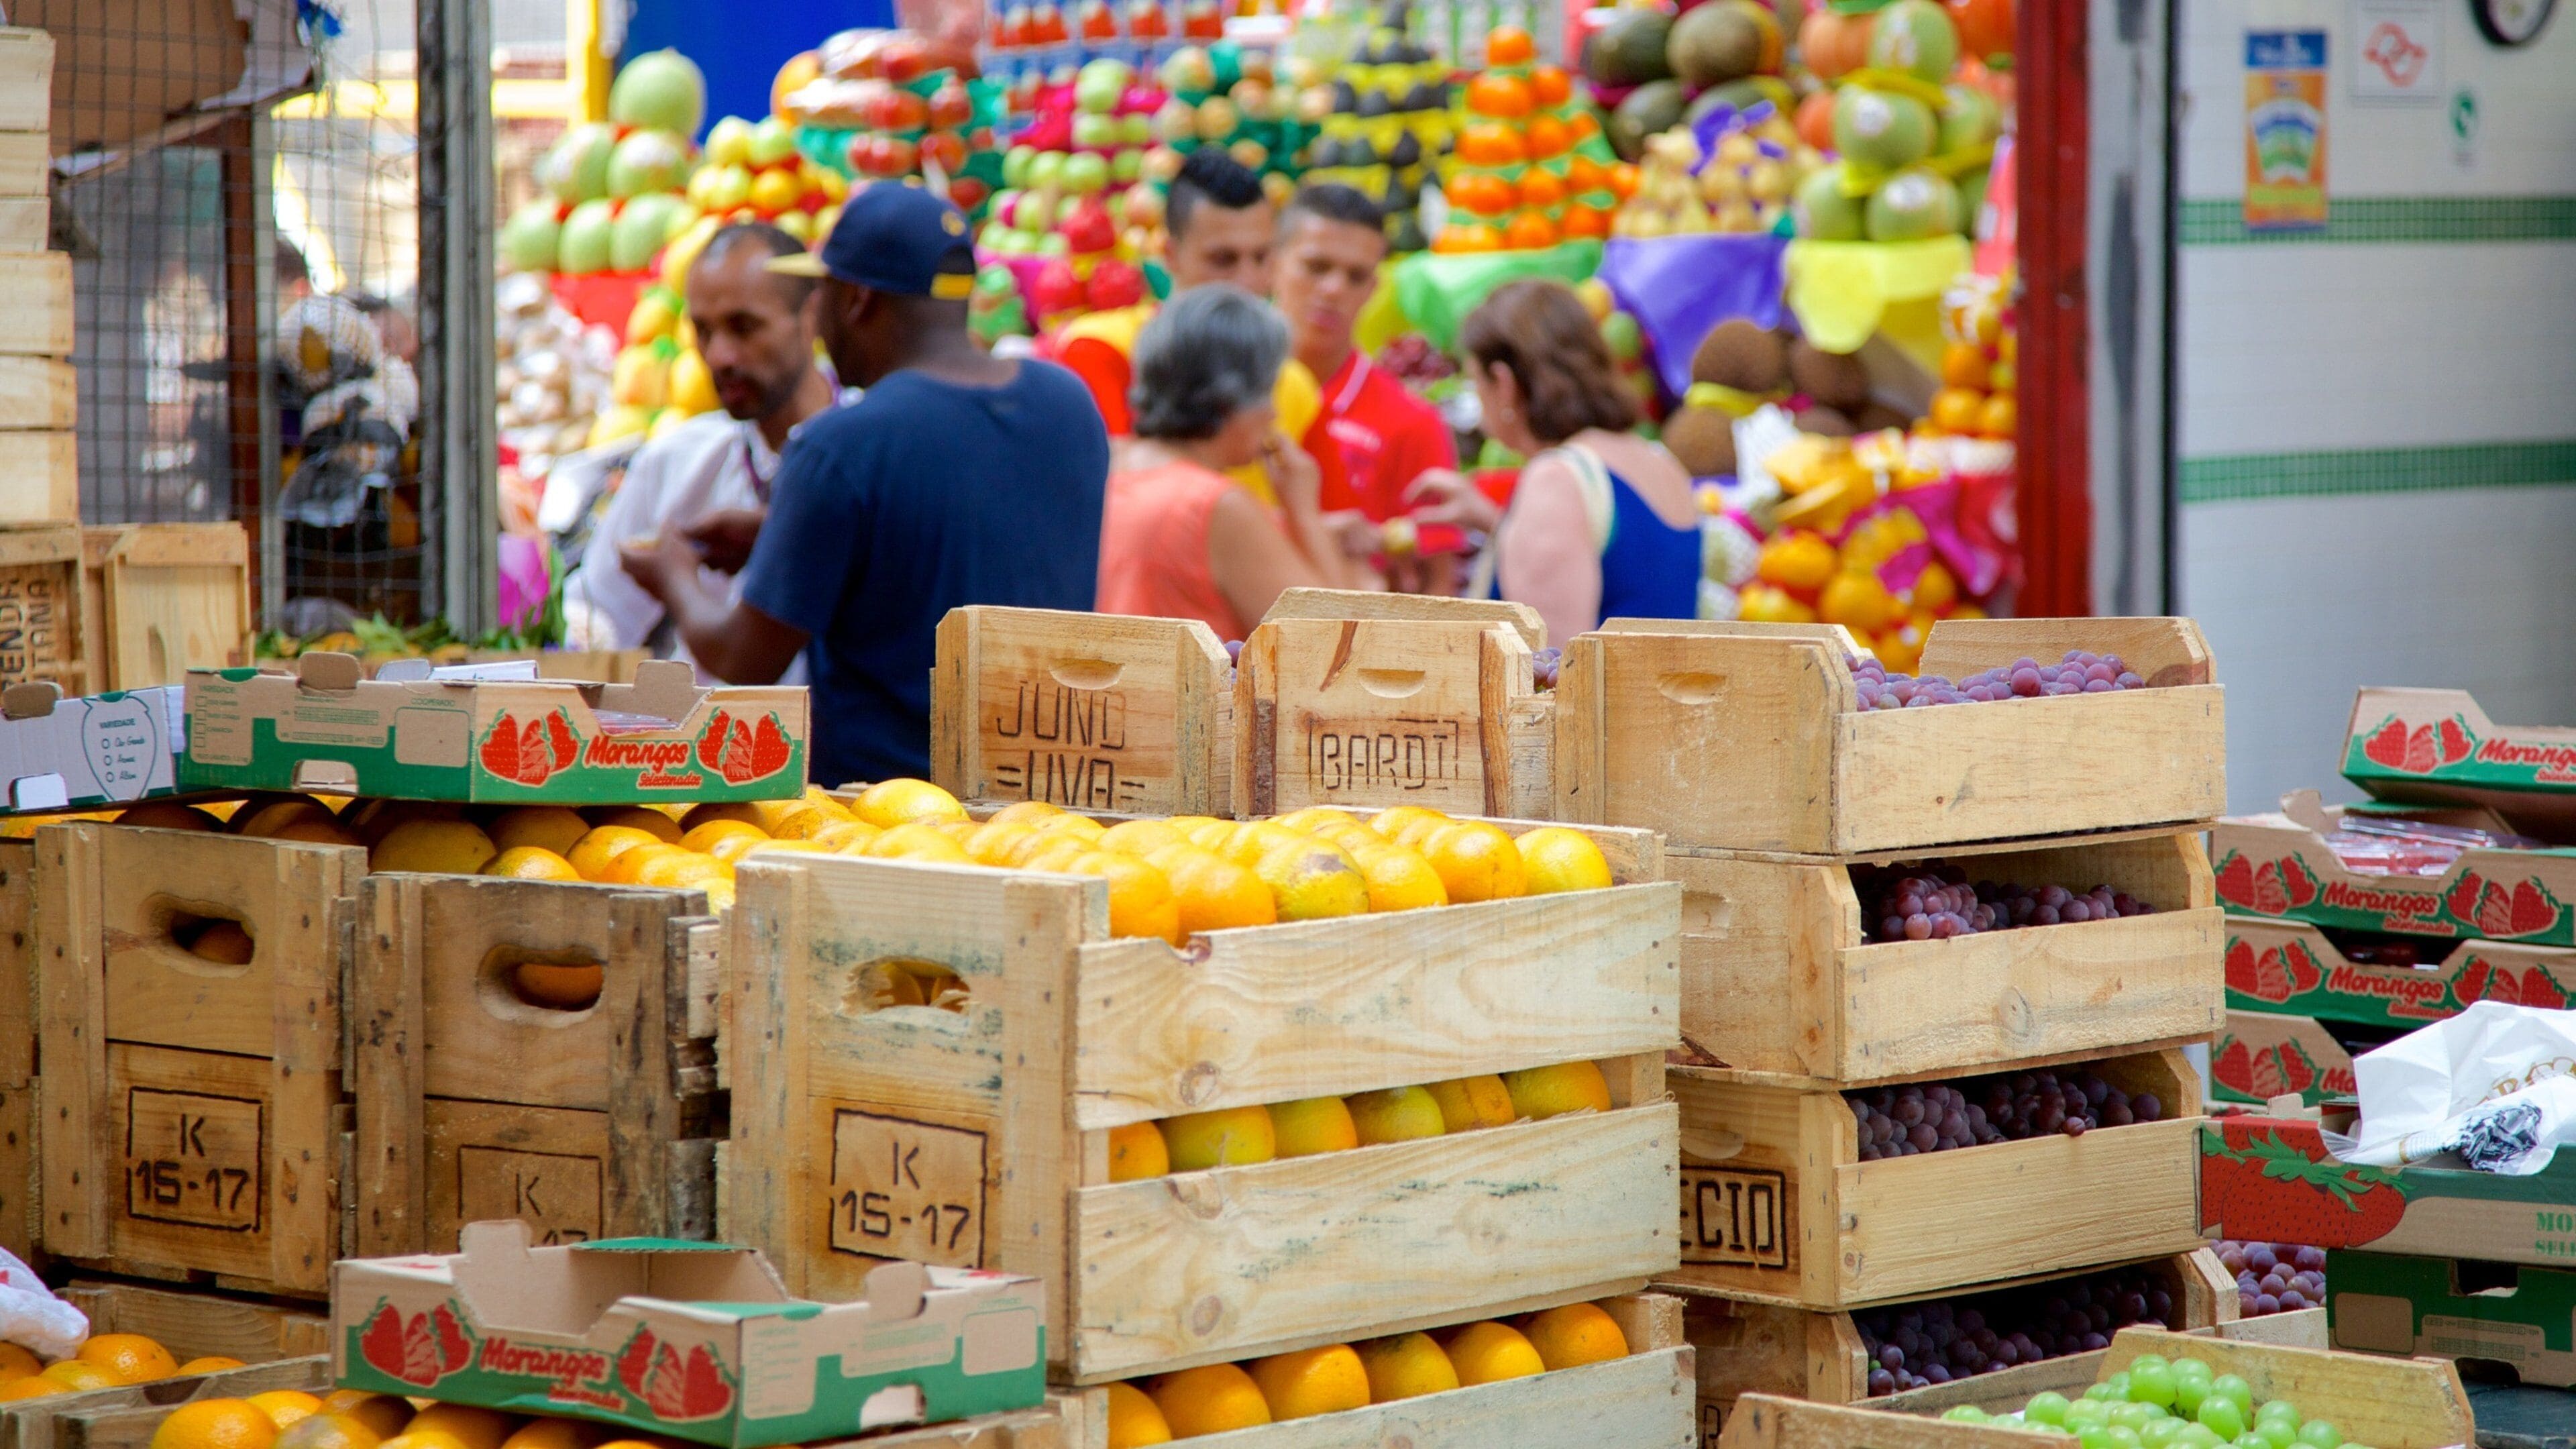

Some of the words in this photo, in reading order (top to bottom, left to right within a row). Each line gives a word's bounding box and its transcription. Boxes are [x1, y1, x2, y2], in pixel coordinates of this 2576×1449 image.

[585, 735, 688, 773] Morangos
[1320, 733, 1449, 791] BARDI
[2324, 881, 2438, 918] Morangos
[2328, 966, 2444, 1005] Morangos
[180, 1113, 205, 1157] K
[135, 1160, 251, 1213] 15-17
[893, 1141, 920, 1190] K
[515, 1173, 541, 1217] K
[839, 1190, 970, 1250] 15-17
[2536, 1213, 2576, 1233] MO
[480, 1337, 607, 1387] Morangos
